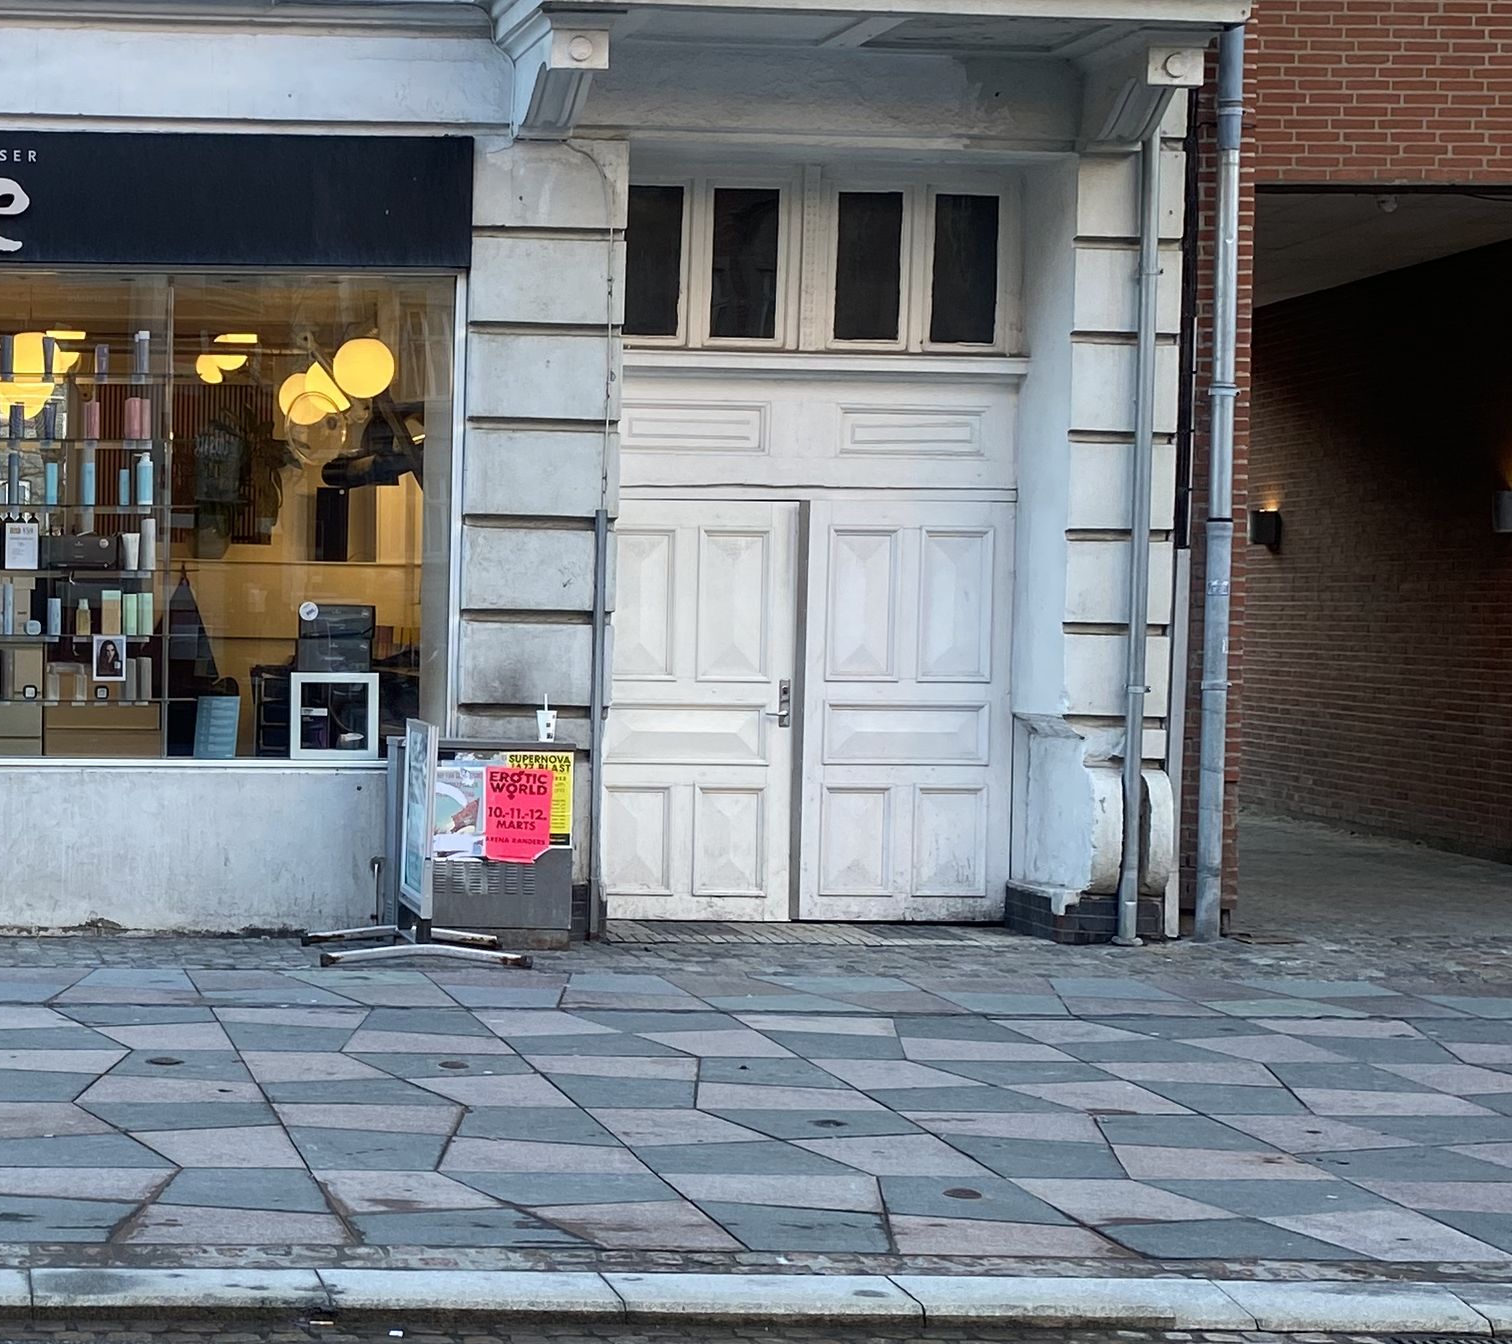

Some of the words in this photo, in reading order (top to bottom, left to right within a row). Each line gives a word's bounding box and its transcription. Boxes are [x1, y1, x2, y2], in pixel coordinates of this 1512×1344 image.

[508, 754, 571, 764] SUPERNOVA
[489, 771, 548, 785] EROTIC
[490, 782, 548, 797] WORLD
[496, 820, 537, 831] MARTS
[485, 836, 509, 844] ARENA
[511, 838, 546, 846] RANDERS
